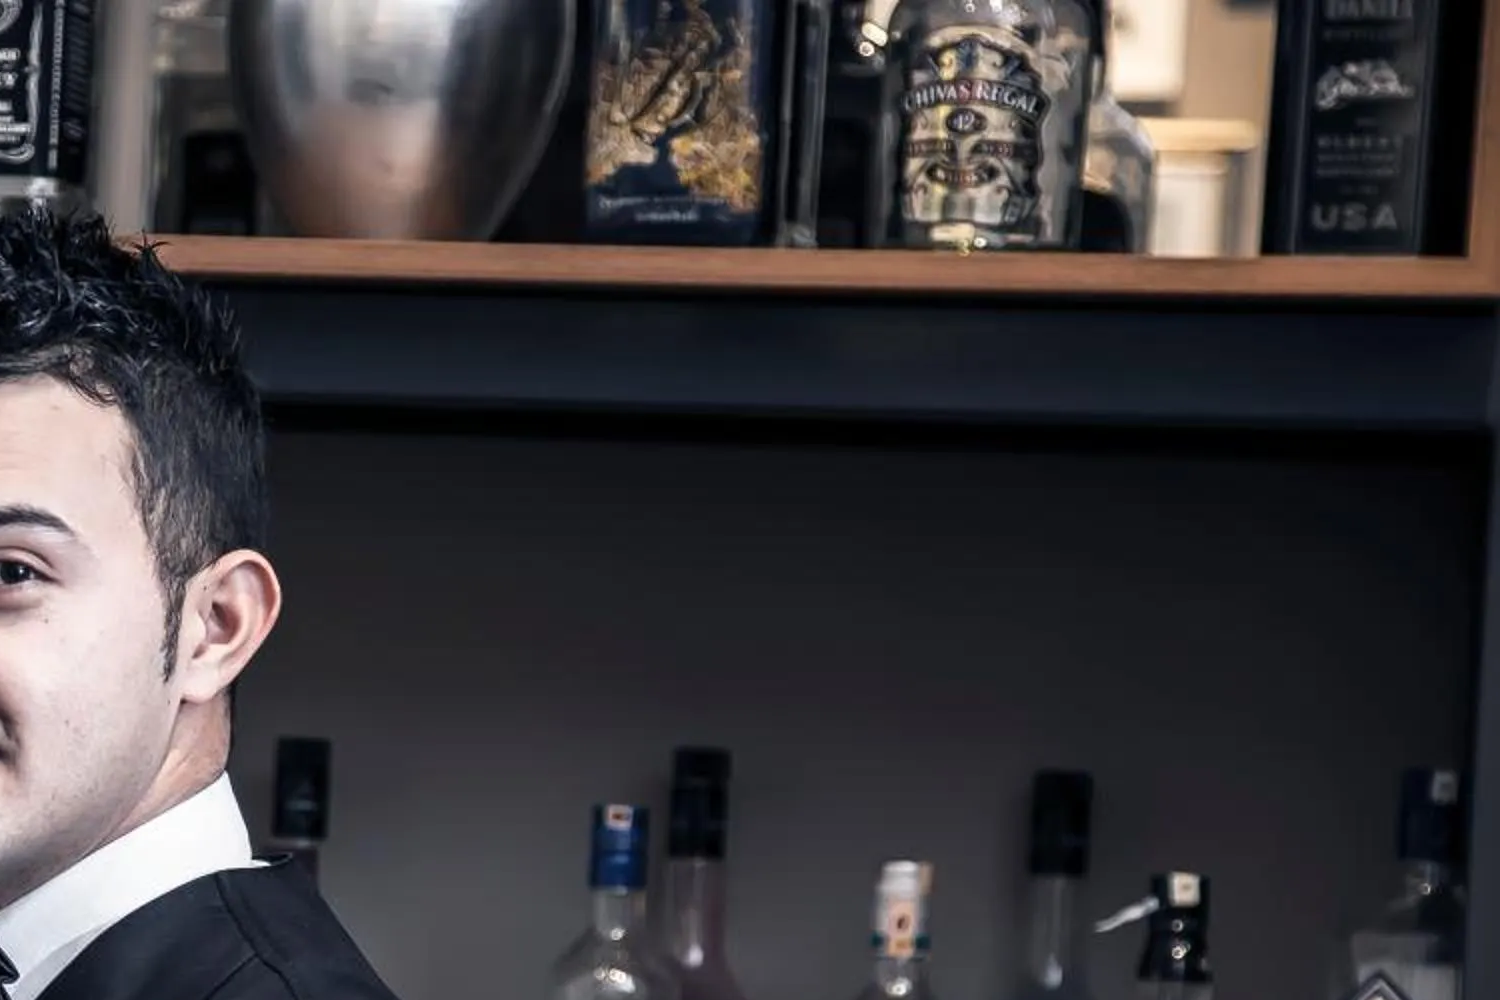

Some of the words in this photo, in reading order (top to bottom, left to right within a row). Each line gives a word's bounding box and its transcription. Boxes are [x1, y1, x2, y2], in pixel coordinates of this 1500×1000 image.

[904, 78, 971, 111] CHIVAS
[975, 78, 1040, 114] REGAL
[1311, 203, 1398, 231] USA
